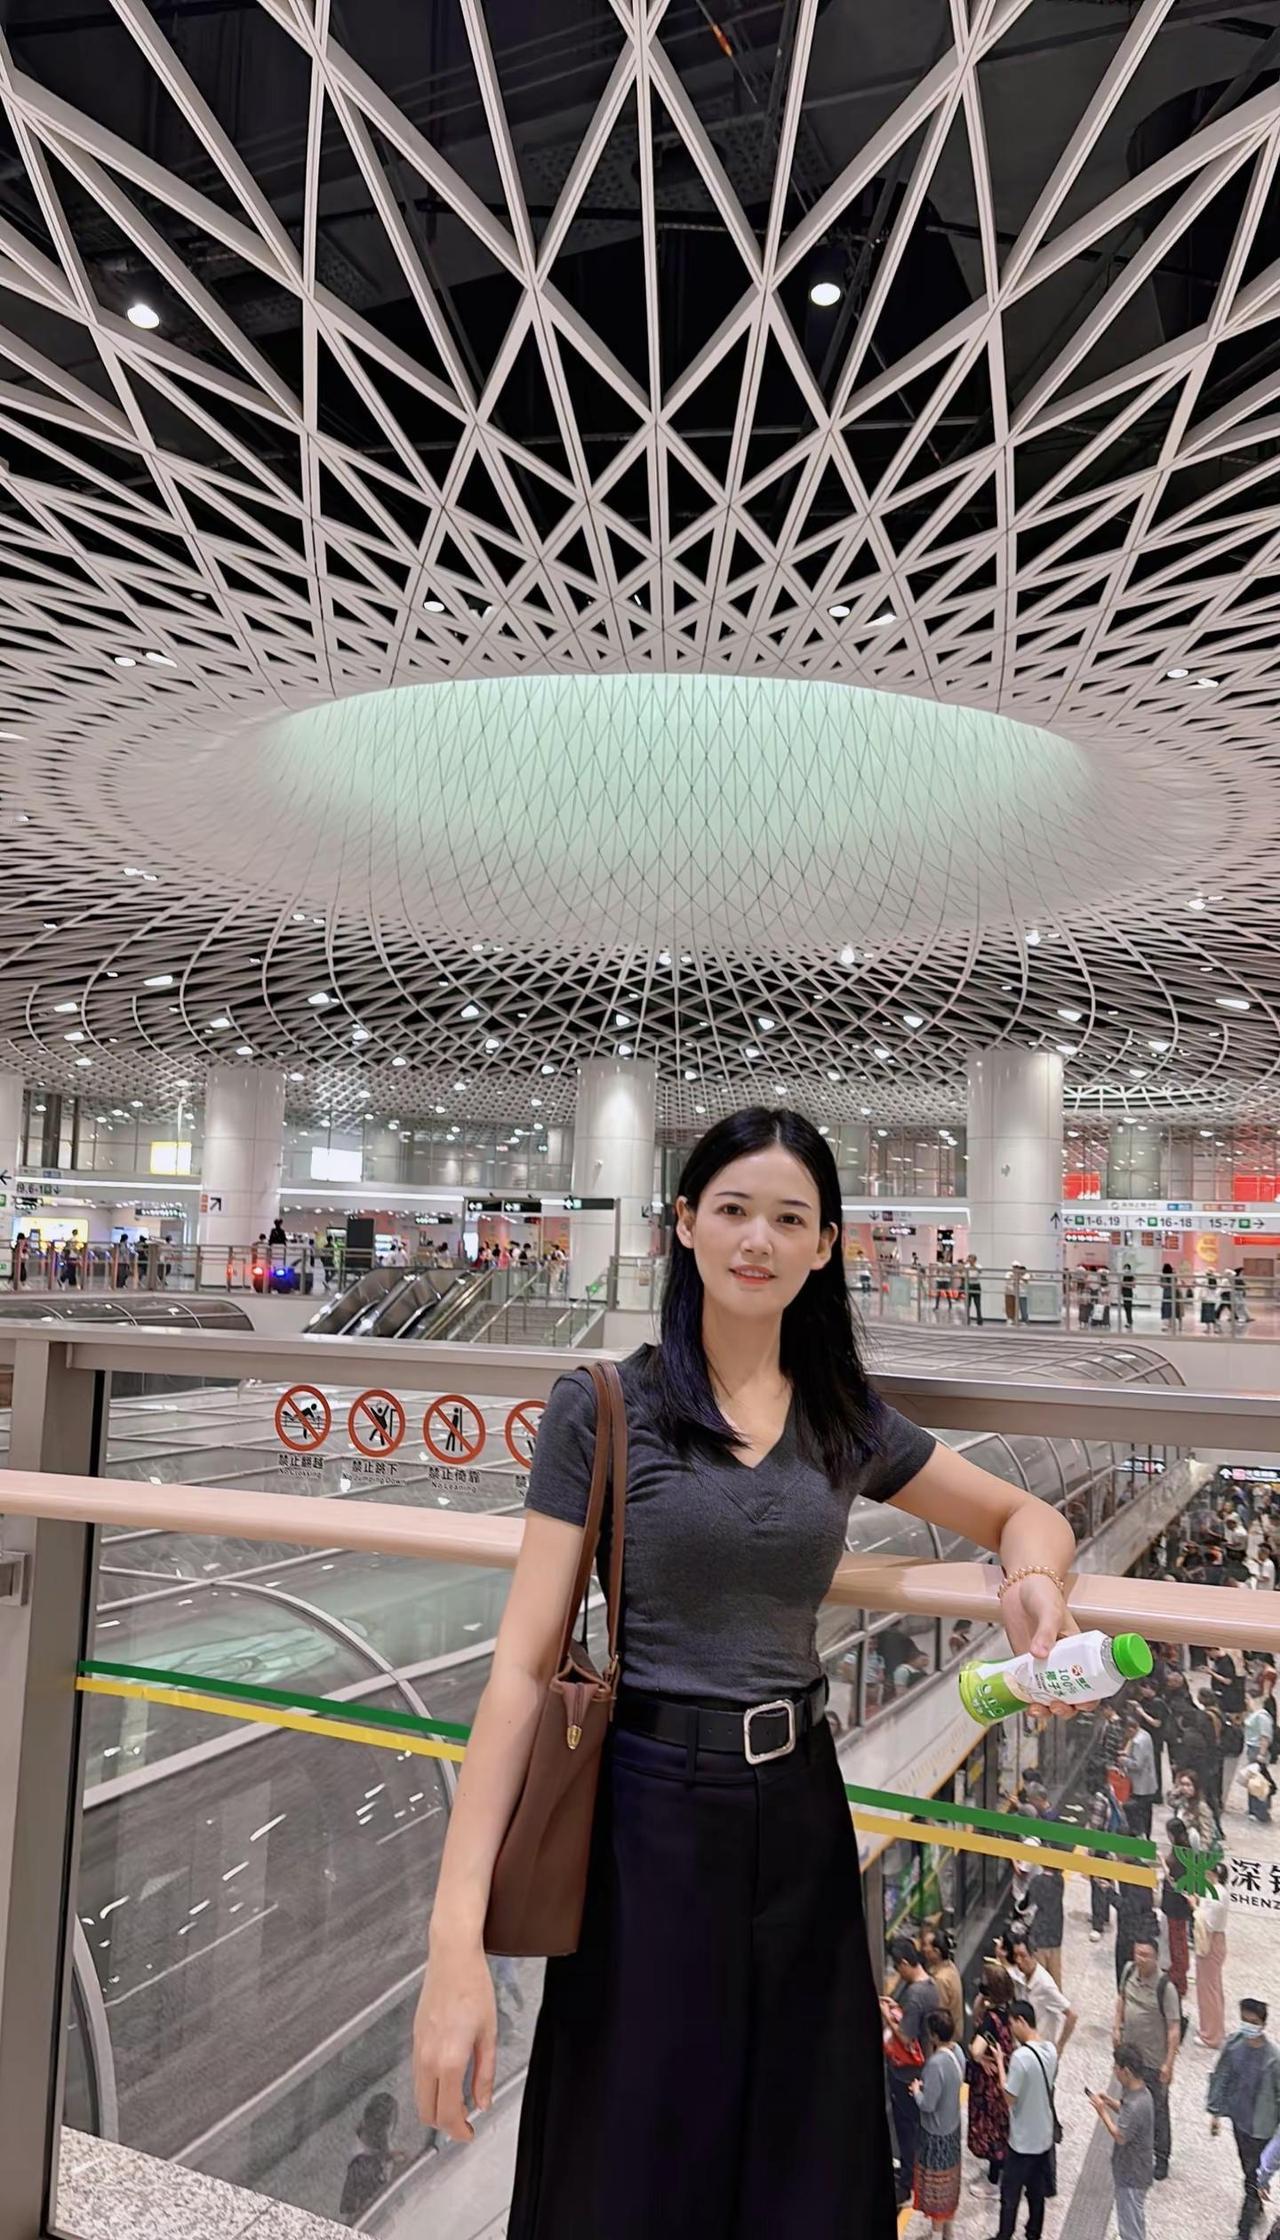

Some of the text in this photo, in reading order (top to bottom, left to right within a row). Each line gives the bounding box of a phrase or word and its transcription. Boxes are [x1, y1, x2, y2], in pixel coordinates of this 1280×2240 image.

[1160, 1217, 1192, 1228] 16-18
[1209, 1218, 1236, 1228] 15-7
[352, 1460, 398, 1475] 禁止跳下
[429, 1466, 480, 1483] 禁止倚靠
